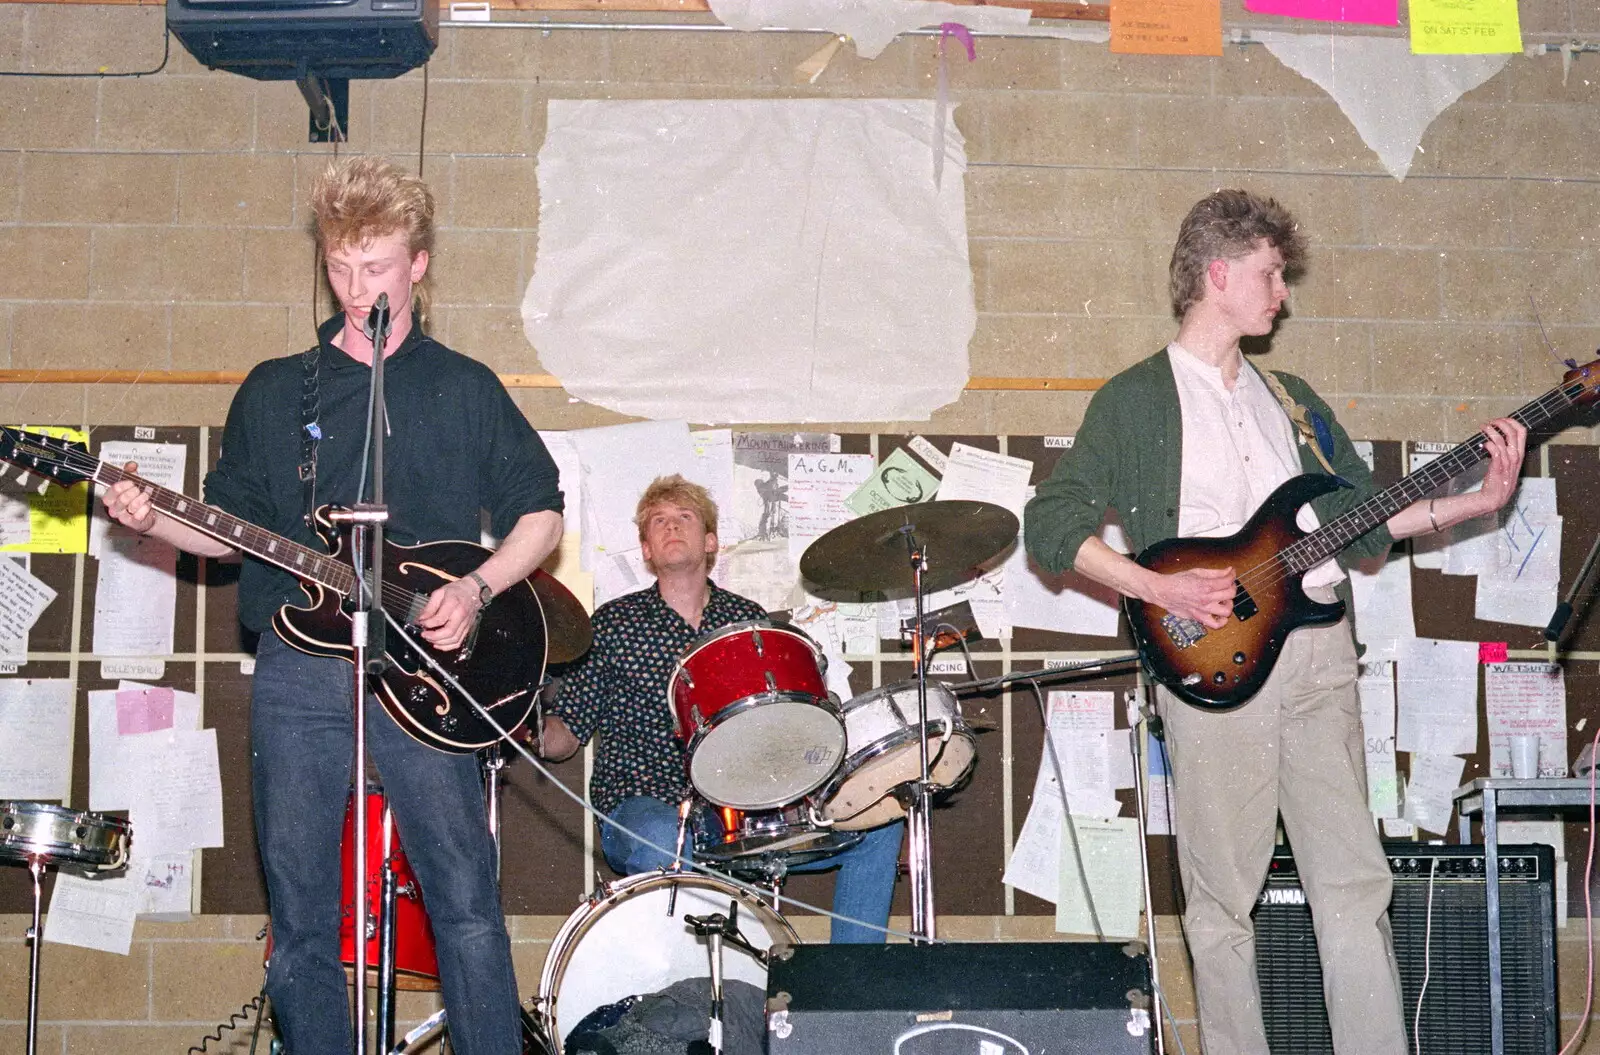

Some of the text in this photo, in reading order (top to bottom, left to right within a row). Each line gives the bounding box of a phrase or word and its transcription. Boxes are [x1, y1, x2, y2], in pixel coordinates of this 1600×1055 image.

[1442, 26, 1457, 36] SAT
[1474, 27, 1496, 37] FEB
[137, 429, 154, 439] SKI
[1045, 438, 1073, 447] WALK
[103, 665, 160, 675] VOLLEYBALL
